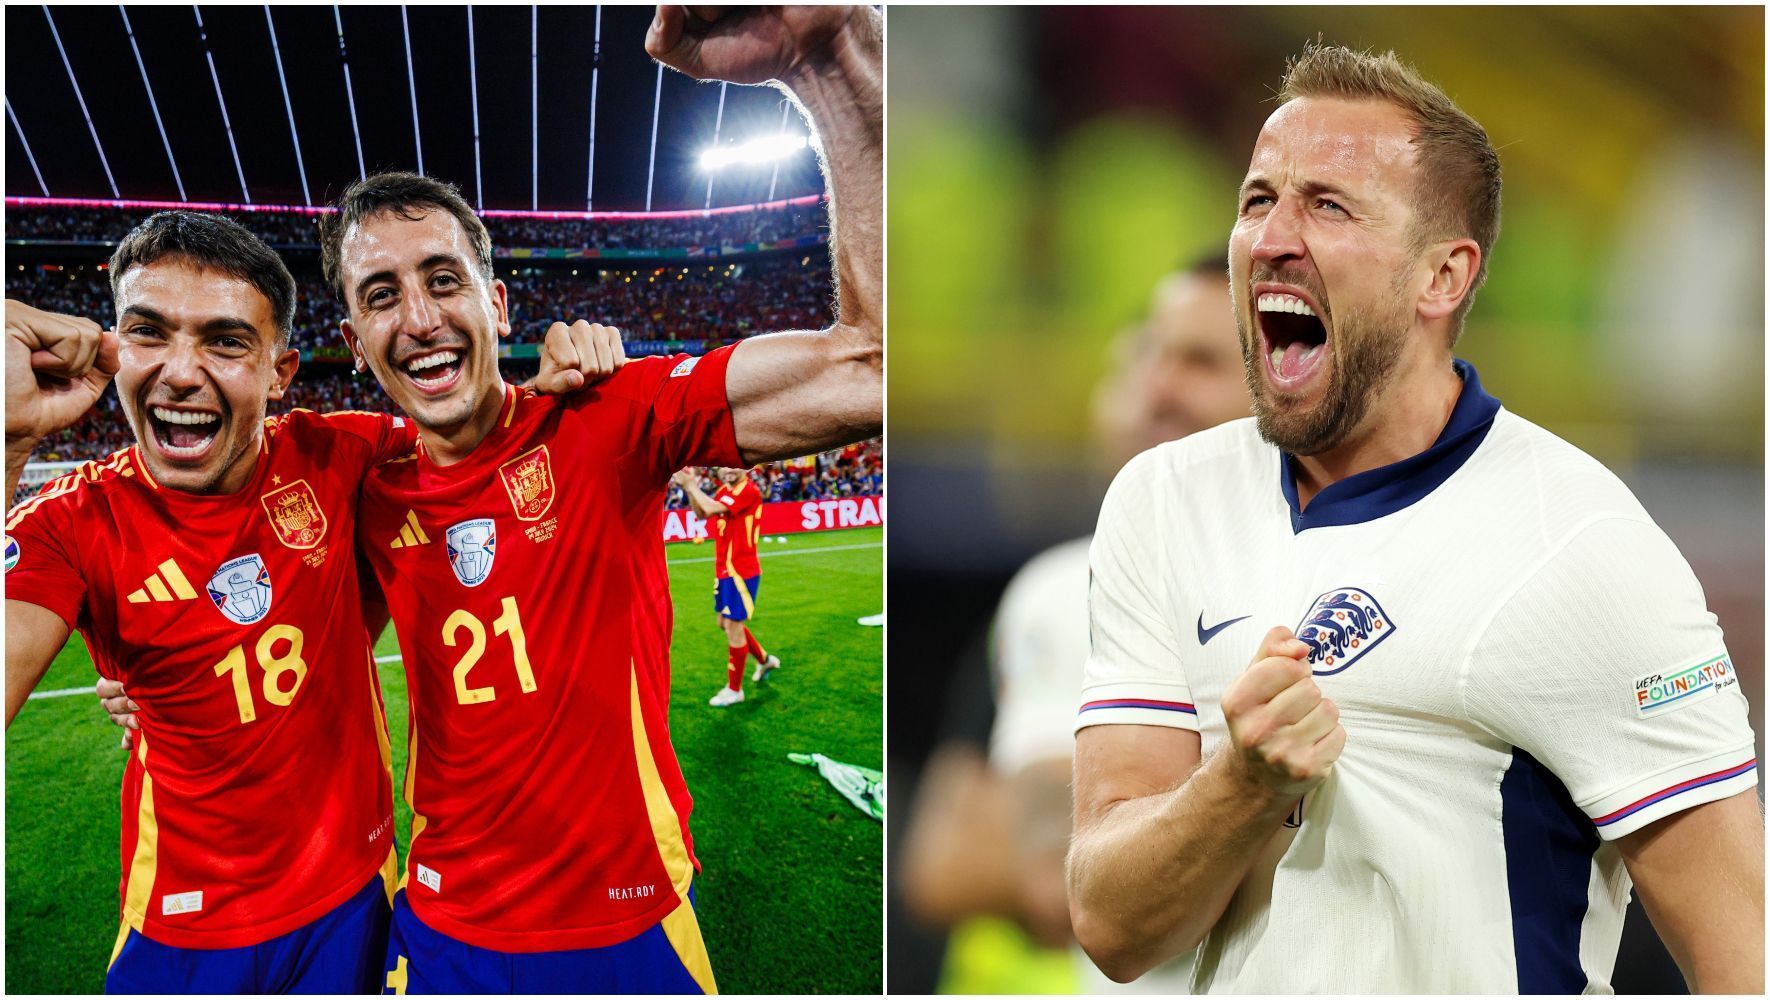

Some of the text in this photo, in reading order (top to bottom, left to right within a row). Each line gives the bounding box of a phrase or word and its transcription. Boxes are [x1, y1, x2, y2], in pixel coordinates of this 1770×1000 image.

[801, 497, 884, 530] STRA
[442, 596, 538, 705] 21
[214, 624, 308, 724] 18
[1636, 674, 1662, 690] UEFA
[608, 884, 655, 900] HEAT.RDY
